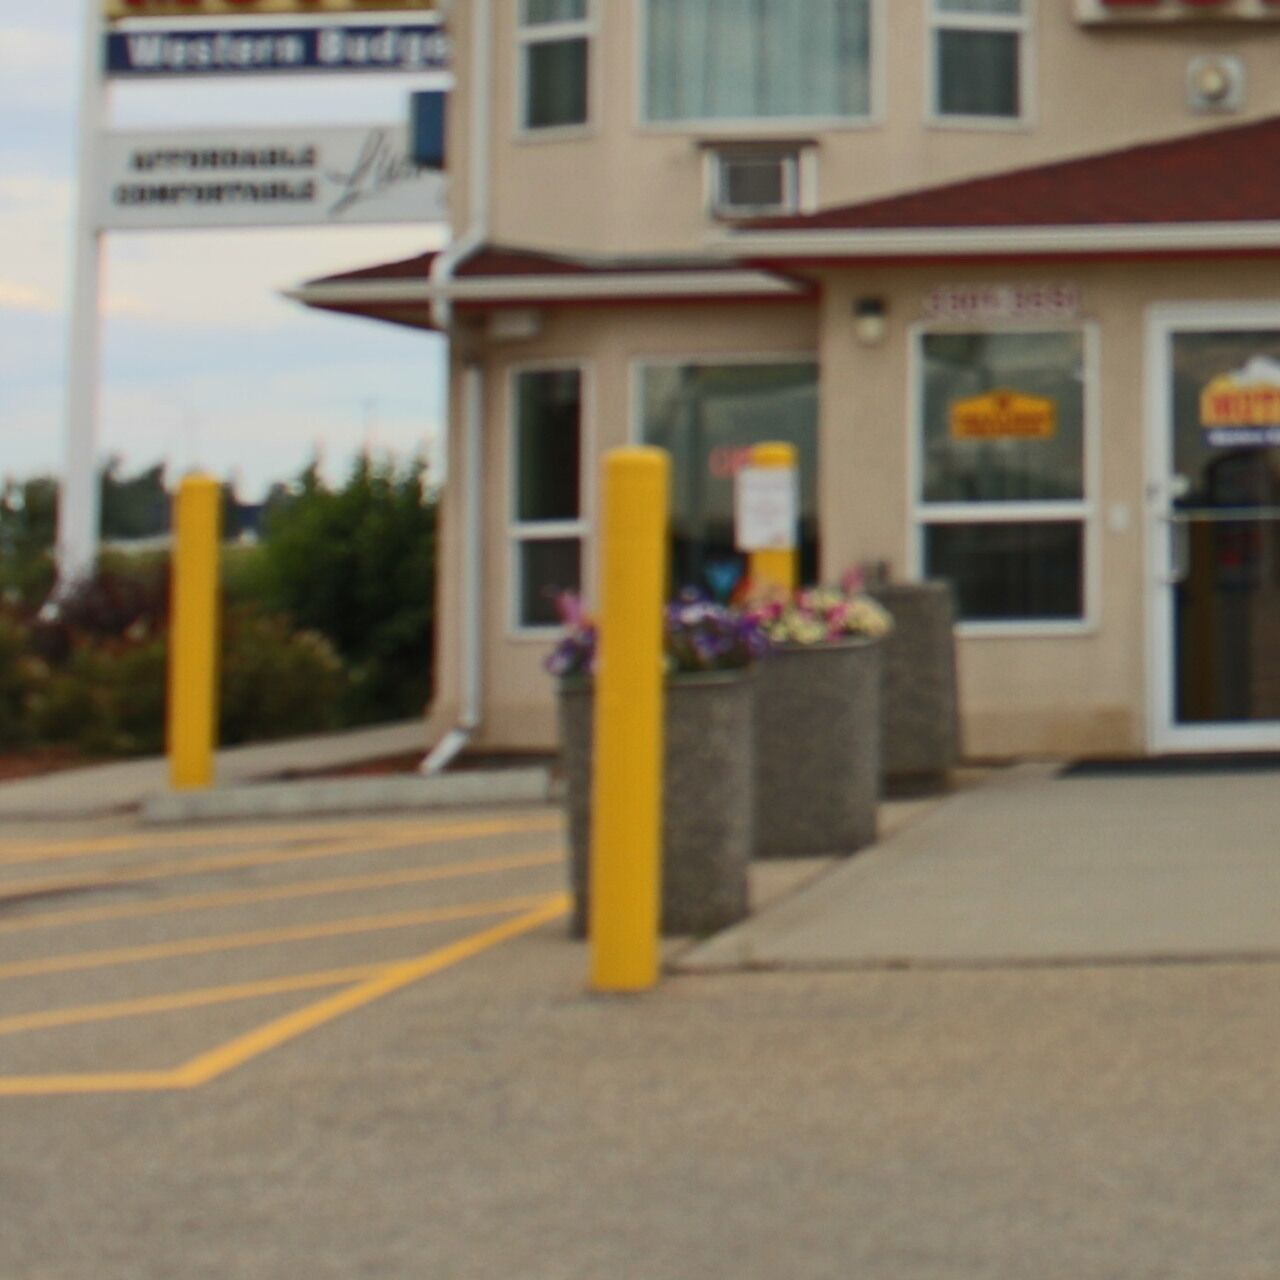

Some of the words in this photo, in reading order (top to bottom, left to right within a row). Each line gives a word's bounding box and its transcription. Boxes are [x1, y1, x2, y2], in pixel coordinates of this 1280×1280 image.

[129, 31, 305, 67] Western
[130, 147, 316, 171] AFFORDABLE
[114, 183, 316, 207] COMFORTABLE
